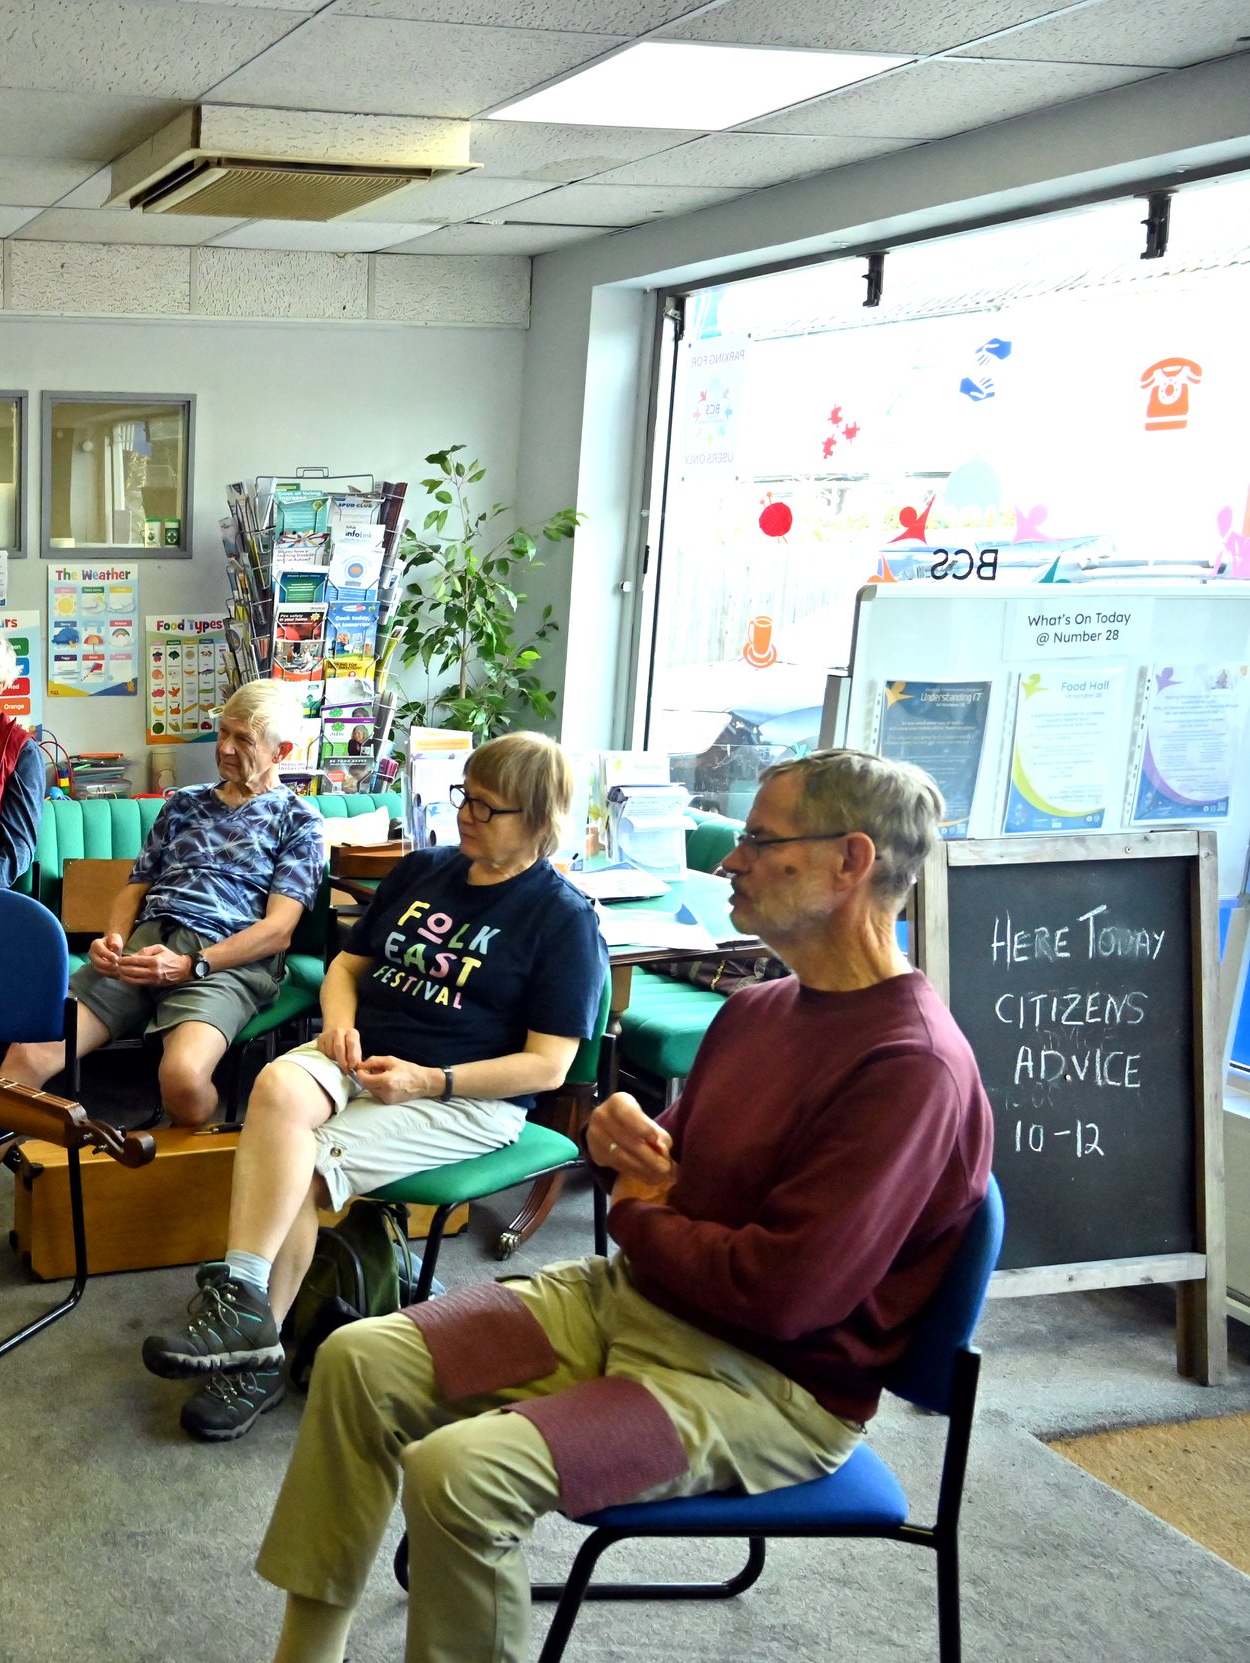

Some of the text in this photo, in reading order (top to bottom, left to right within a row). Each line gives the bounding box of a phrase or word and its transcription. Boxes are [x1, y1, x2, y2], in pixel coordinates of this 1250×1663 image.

[55, 567, 131, 581] The Weather
[157, 619, 222, 634] Food Types
[1027, 611, 1132, 627] What's On Today
[1035, 629, 1120, 647] @ Number 28
[921, 693, 983, 704] Understanding IT
[1062, 681, 1109, 691] Food Hall
[397, 900, 501, 955] FOLK
[990, 904, 1167, 971] HERE TODAY
[384, 931, 482, 987] EAST
[372, 965, 462, 1009] FESTIVAL
[994, 990, 1149, 1030] CITIZENS
[1013, 1045, 1142, 1088] ADVICE
[1014, 1119, 1105, 1158] 10-12
